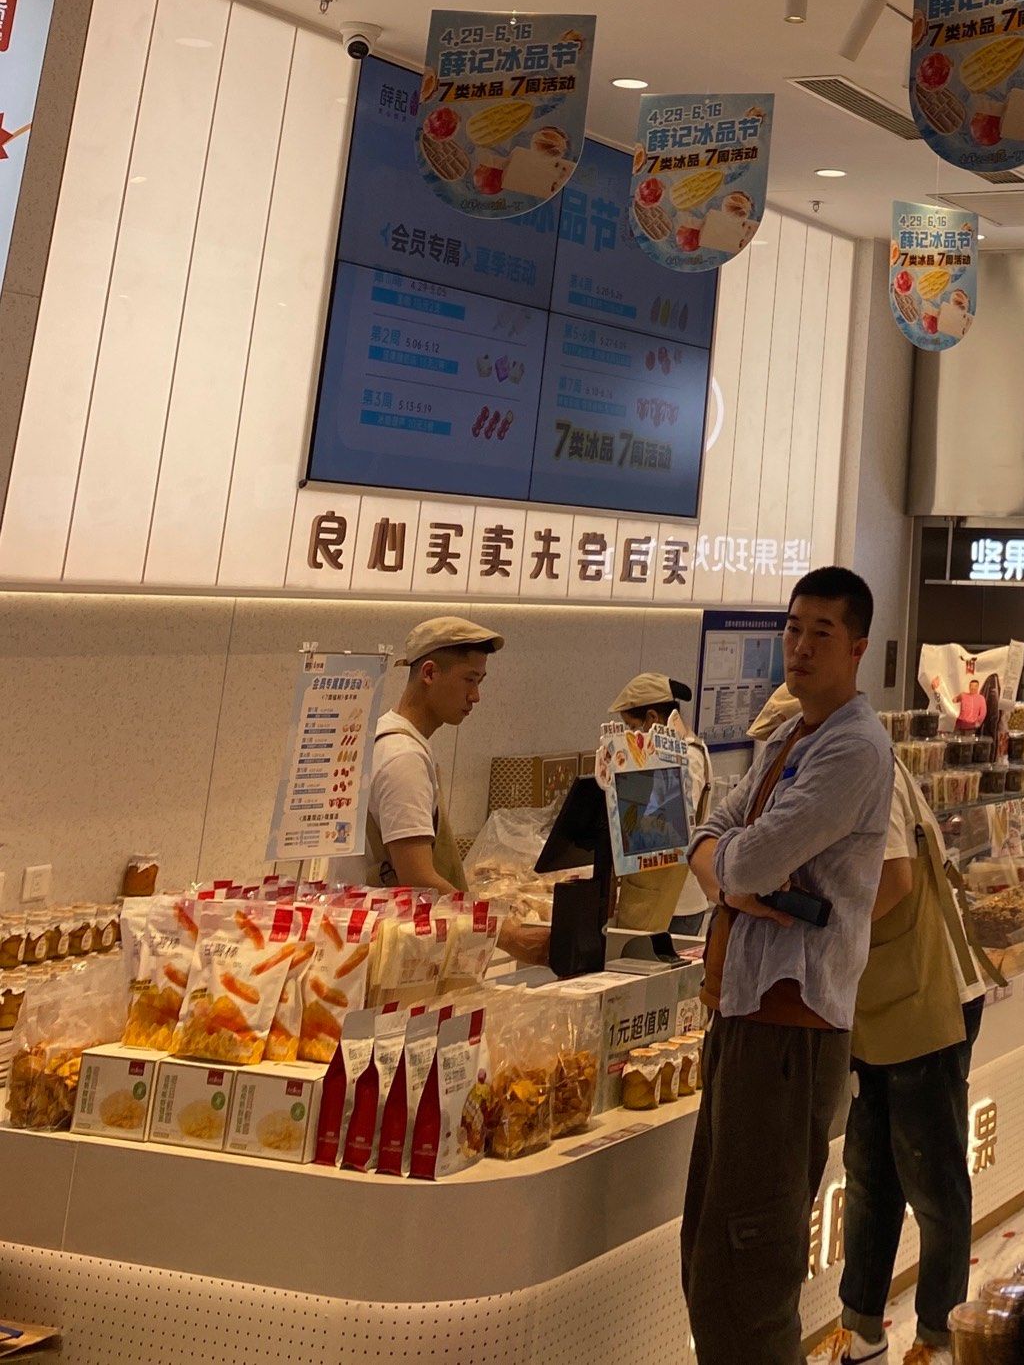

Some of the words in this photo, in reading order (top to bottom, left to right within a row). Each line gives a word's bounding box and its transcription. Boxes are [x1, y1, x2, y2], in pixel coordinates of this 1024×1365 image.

[441, 23, 532, 46] 4.29-6.16
[928, 16, 996, 46] 7类冰品
[439, 42, 580, 78] 薛记冰品节
[438, 81, 504, 102] 7类冰品
[510, 76, 576, 96] 7周活动
[648, 103, 722, 125] 4.29-6.16
[647, 118, 761, 151] 薛记冰品节
[647, 153, 700, 174] 7类冰品
[705, 146, 758, 166] 7周活动
[391, 223, 463, 267] 会员专属
[900, 231, 971, 249] 薛记冰品节
[609, 1006, 670, 1047] 1元超值购
